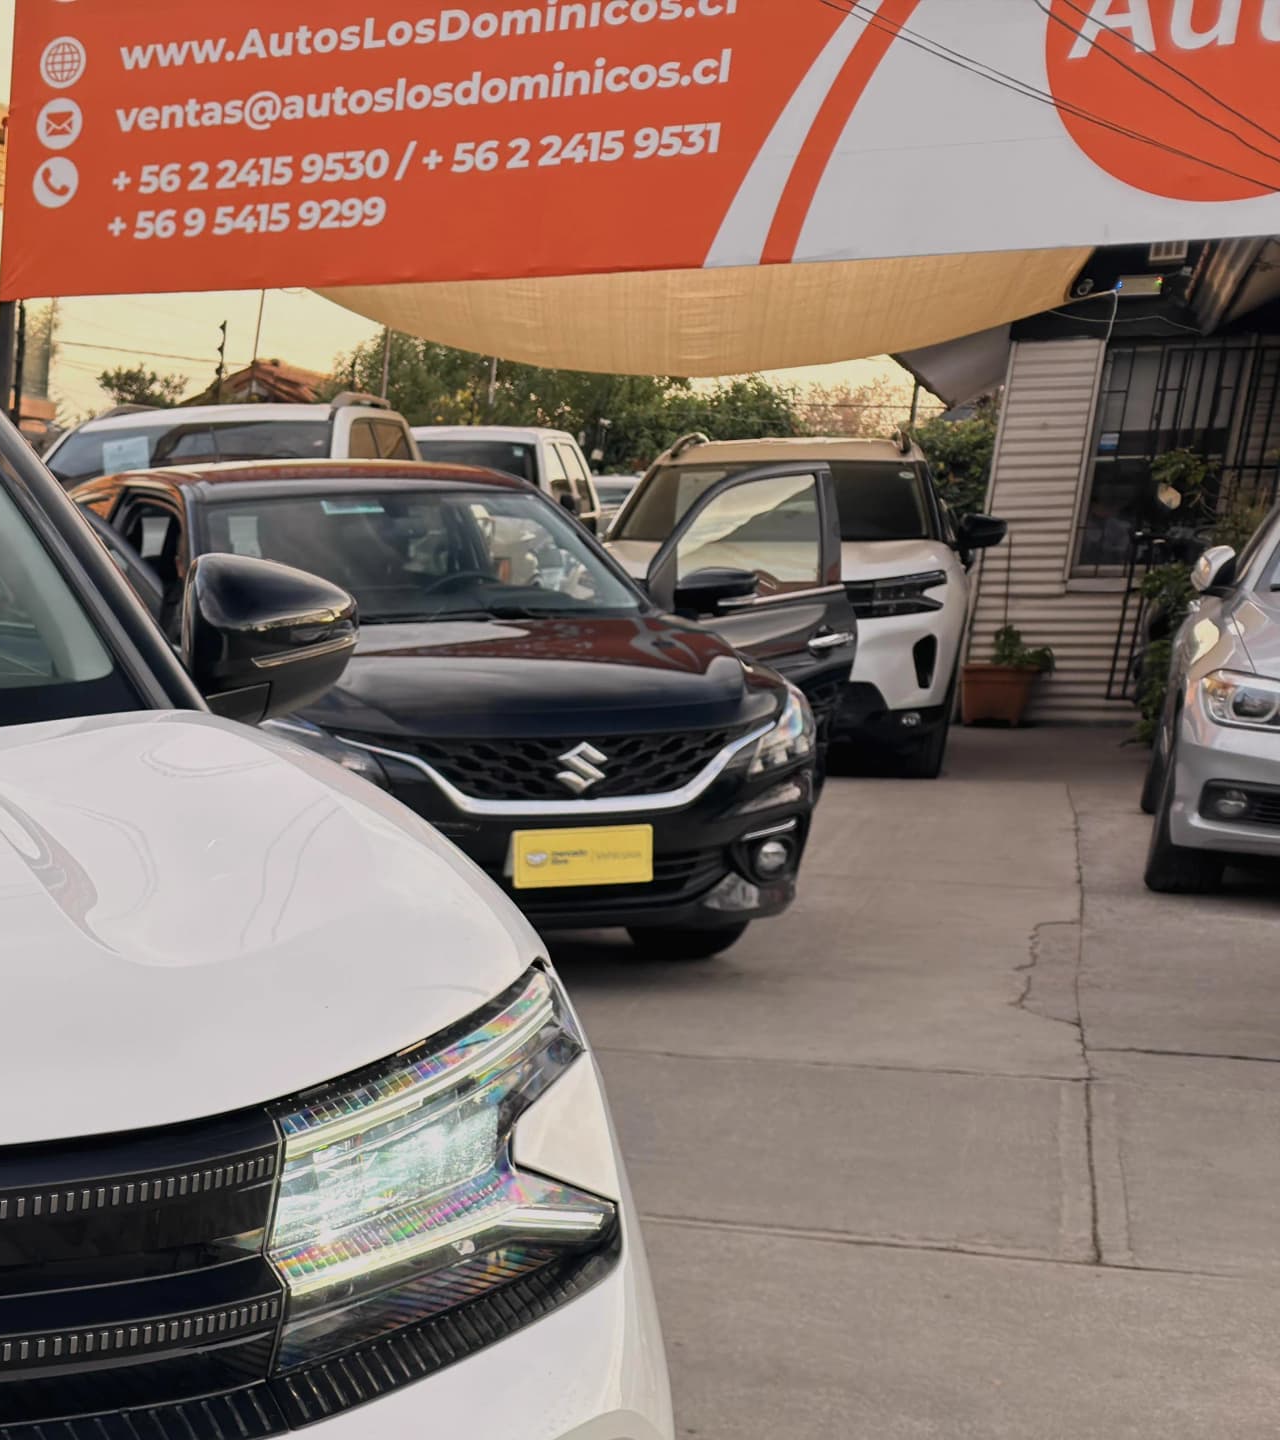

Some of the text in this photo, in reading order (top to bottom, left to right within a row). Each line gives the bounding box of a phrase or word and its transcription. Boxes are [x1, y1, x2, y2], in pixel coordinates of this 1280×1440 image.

[115, 48, 733, 133] ventas@autoslosdominicos.cl
[137, 163, 182, 194] 56
[186, 160, 210, 192] 2
[215, 155, 294, 190] 2415
[300, 148, 390, 184] 9530
[450, 140, 500, 173] 56
[506, 137, 532, 169] 2
[537, 129, 625, 167] 2415
[632, 122, 722, 160] 9531
[132, 208, 178, 240] 56
[182, 206, 207, 238] 9
[211, 202, 292, 236] 5415
[296, 195, 388, 231] 9299
